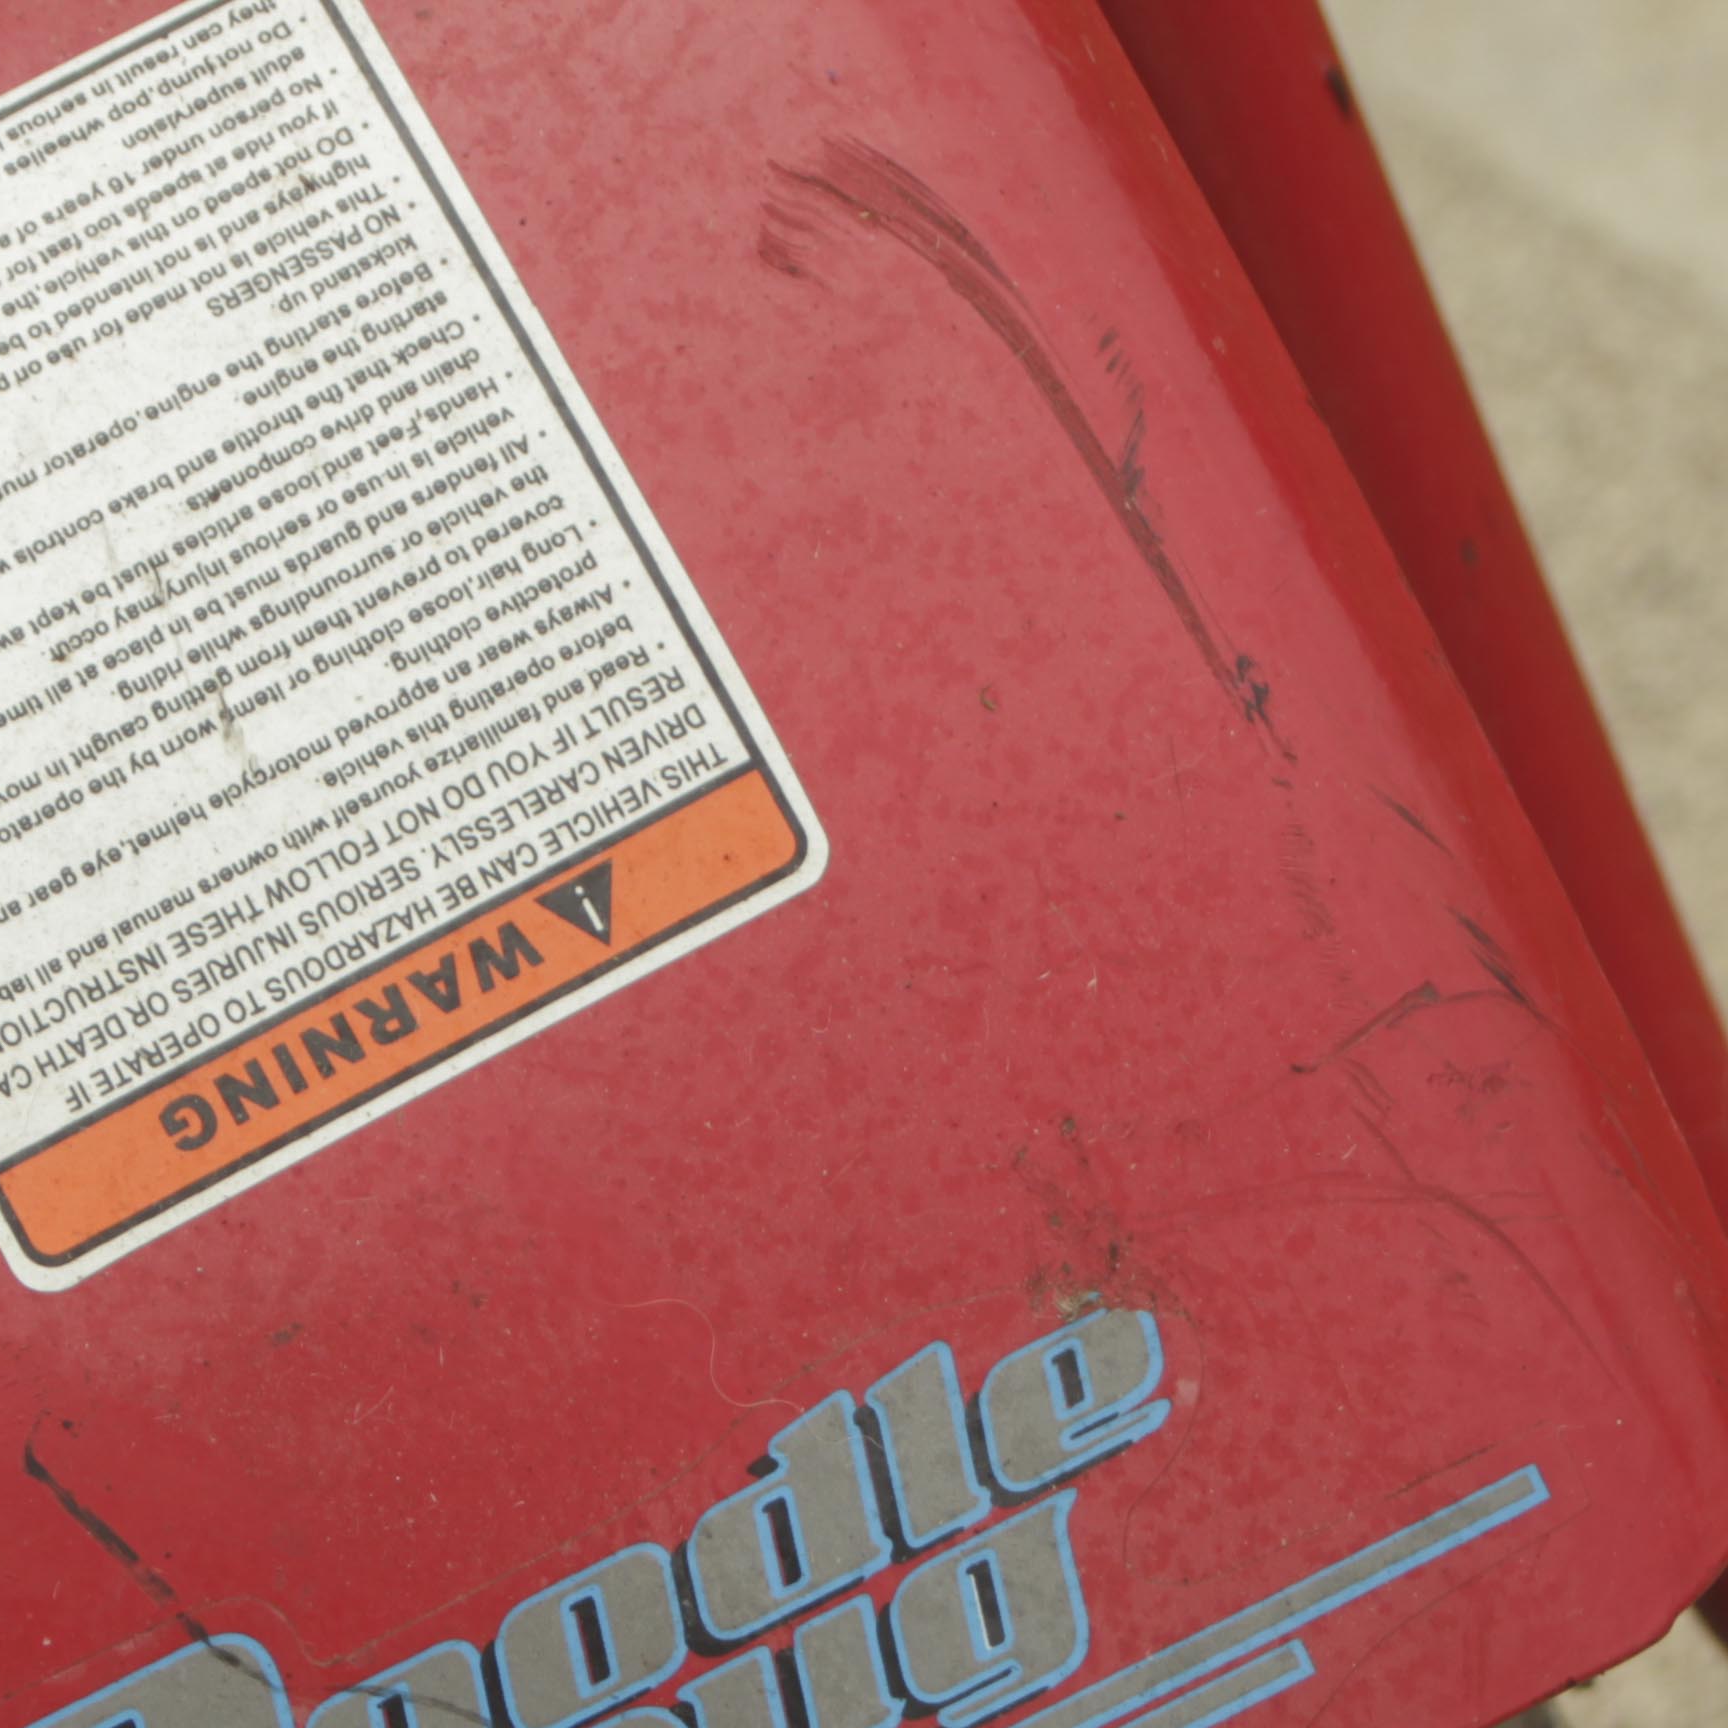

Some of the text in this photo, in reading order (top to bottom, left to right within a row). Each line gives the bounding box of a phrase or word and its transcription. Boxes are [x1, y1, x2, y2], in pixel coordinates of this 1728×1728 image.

[114, 45, 179, 87] result
[5, 91, 88, 141] serious
[120, 45, 305, 149] adult supervision
[208, 87, 286, 138] person
[2, 117, 105, 176] wheelies
[141, 133, 205, 175] under
[231, 130, 275, 161] ride
[40, 180, 105, 225] years
[122, 168, 203, 222] speeds
[202, 167, 273, 215] speed
[335, 182, 387, 213] This
[37, 232, 83, 265] fast
[126, 222, 170, 251] this
[252, 208, 334, 256] vehicle
[204, 203, 402, 318] NO PASSENGERS
[309, 232, 419, 301] kickstand
[354, 260, 434, 310] Before
[52, 266, 154, 329] intended
[124, 282, 188, 324] made
[262, 303, 352, 357] starting
[321, 289, 448, 365] starting the
[390, 319, 465, 366] Check
[224, 350, 265, 378] the
[342, 357, 392, 393] that
[304, 382, 344, 410] the
[319, 346, 480, 440] chain and drive
[220, 403, 304, 455] throttle
[498, 433, 529, 465] All
[174, 447, 218, 485] and
[228, 406, 515, 566] vehicle serious
[320, 445, 364, 482] and
[409, 451, 499, 507] fenders
[509, 463, 549, 492] the
[106, 472, 175, 515] brake
[256, 469, 322, 511] loose
[425, 486, 509, 537] vehicle
[12, 508, 105, 565] controls
[171, 504, 254, 557] articles
[363, 498, 409, 536] and
[470, 493, 565, 557] covered
[282, 519, 363, 574] guards
[519, 523, 584, 563] Long
[222, 566, 281, 609] must
[247, 543, 397, 631] surroundings
[351, 553, 442, 618] prevent
[484, 548, 598, 622] protective
[532, 582, 613, 636] Always
[26, 597, 81, 636] kept
[291, 607, 353, 648] them
[557, 612, 634, 662] before
[101, 624, 165, 671] place
[185, 624, 248, 665] while
[235, 639, 292, 677] from
[310, 617, 405, 676] clothing
[476, 628, 533, 668] wear
[586, 644, 651, 691] Read
[43, 676, 73, 706] all
[149, 665, 233, 722] getting
[333, 676, 440, 747] approved
[447, 654, 556, 721] operating
[540, 677, 585, 715] and
[579, 664, 686, 741] RESULT
[68, 714, 149, 769] caught
[158, 717, 218, 757] worn
[404, 711, 450, 744] this
[422, 702, 542, 773] familiarize
[551, 722, 578, 755] IF
[599, 702, 707, 774] DRIVEN
[86, 765, 128, 795] the
[206, 734, 333, 810] motorcycle
[485, 740, 551, 788] YOU
[330, 760, 423, 829] yourself
[420, 759, 601, 869] CARELESSLY.
[440, 771, 487, 811] DO
[280, 815, 331, 851] with
[381, 795, 441, 846] NOT
[26, 865, 78, 908] gear
[196, 841, 279, 895] owners
[262, 828, 380, 909] FOLLOW
[110, 886, 196, 945] manual
[296, 855, 422, 937] SERIOUS
[64, 742, 725, 1112] THIS VEHICLE CAN BE HAZARDOUS TO OPERATE IF
[64, 931, 110, 969] and
[165, 893, 264, 958] THESE
[33, 956, 63, 986] all
[170, 920, 298, 1004] INJURIES
[122, 990, 170, 1028] OR
[32, 1012, 128, 1078] DEATH
[158, 921, 543, 1151] WARNING
